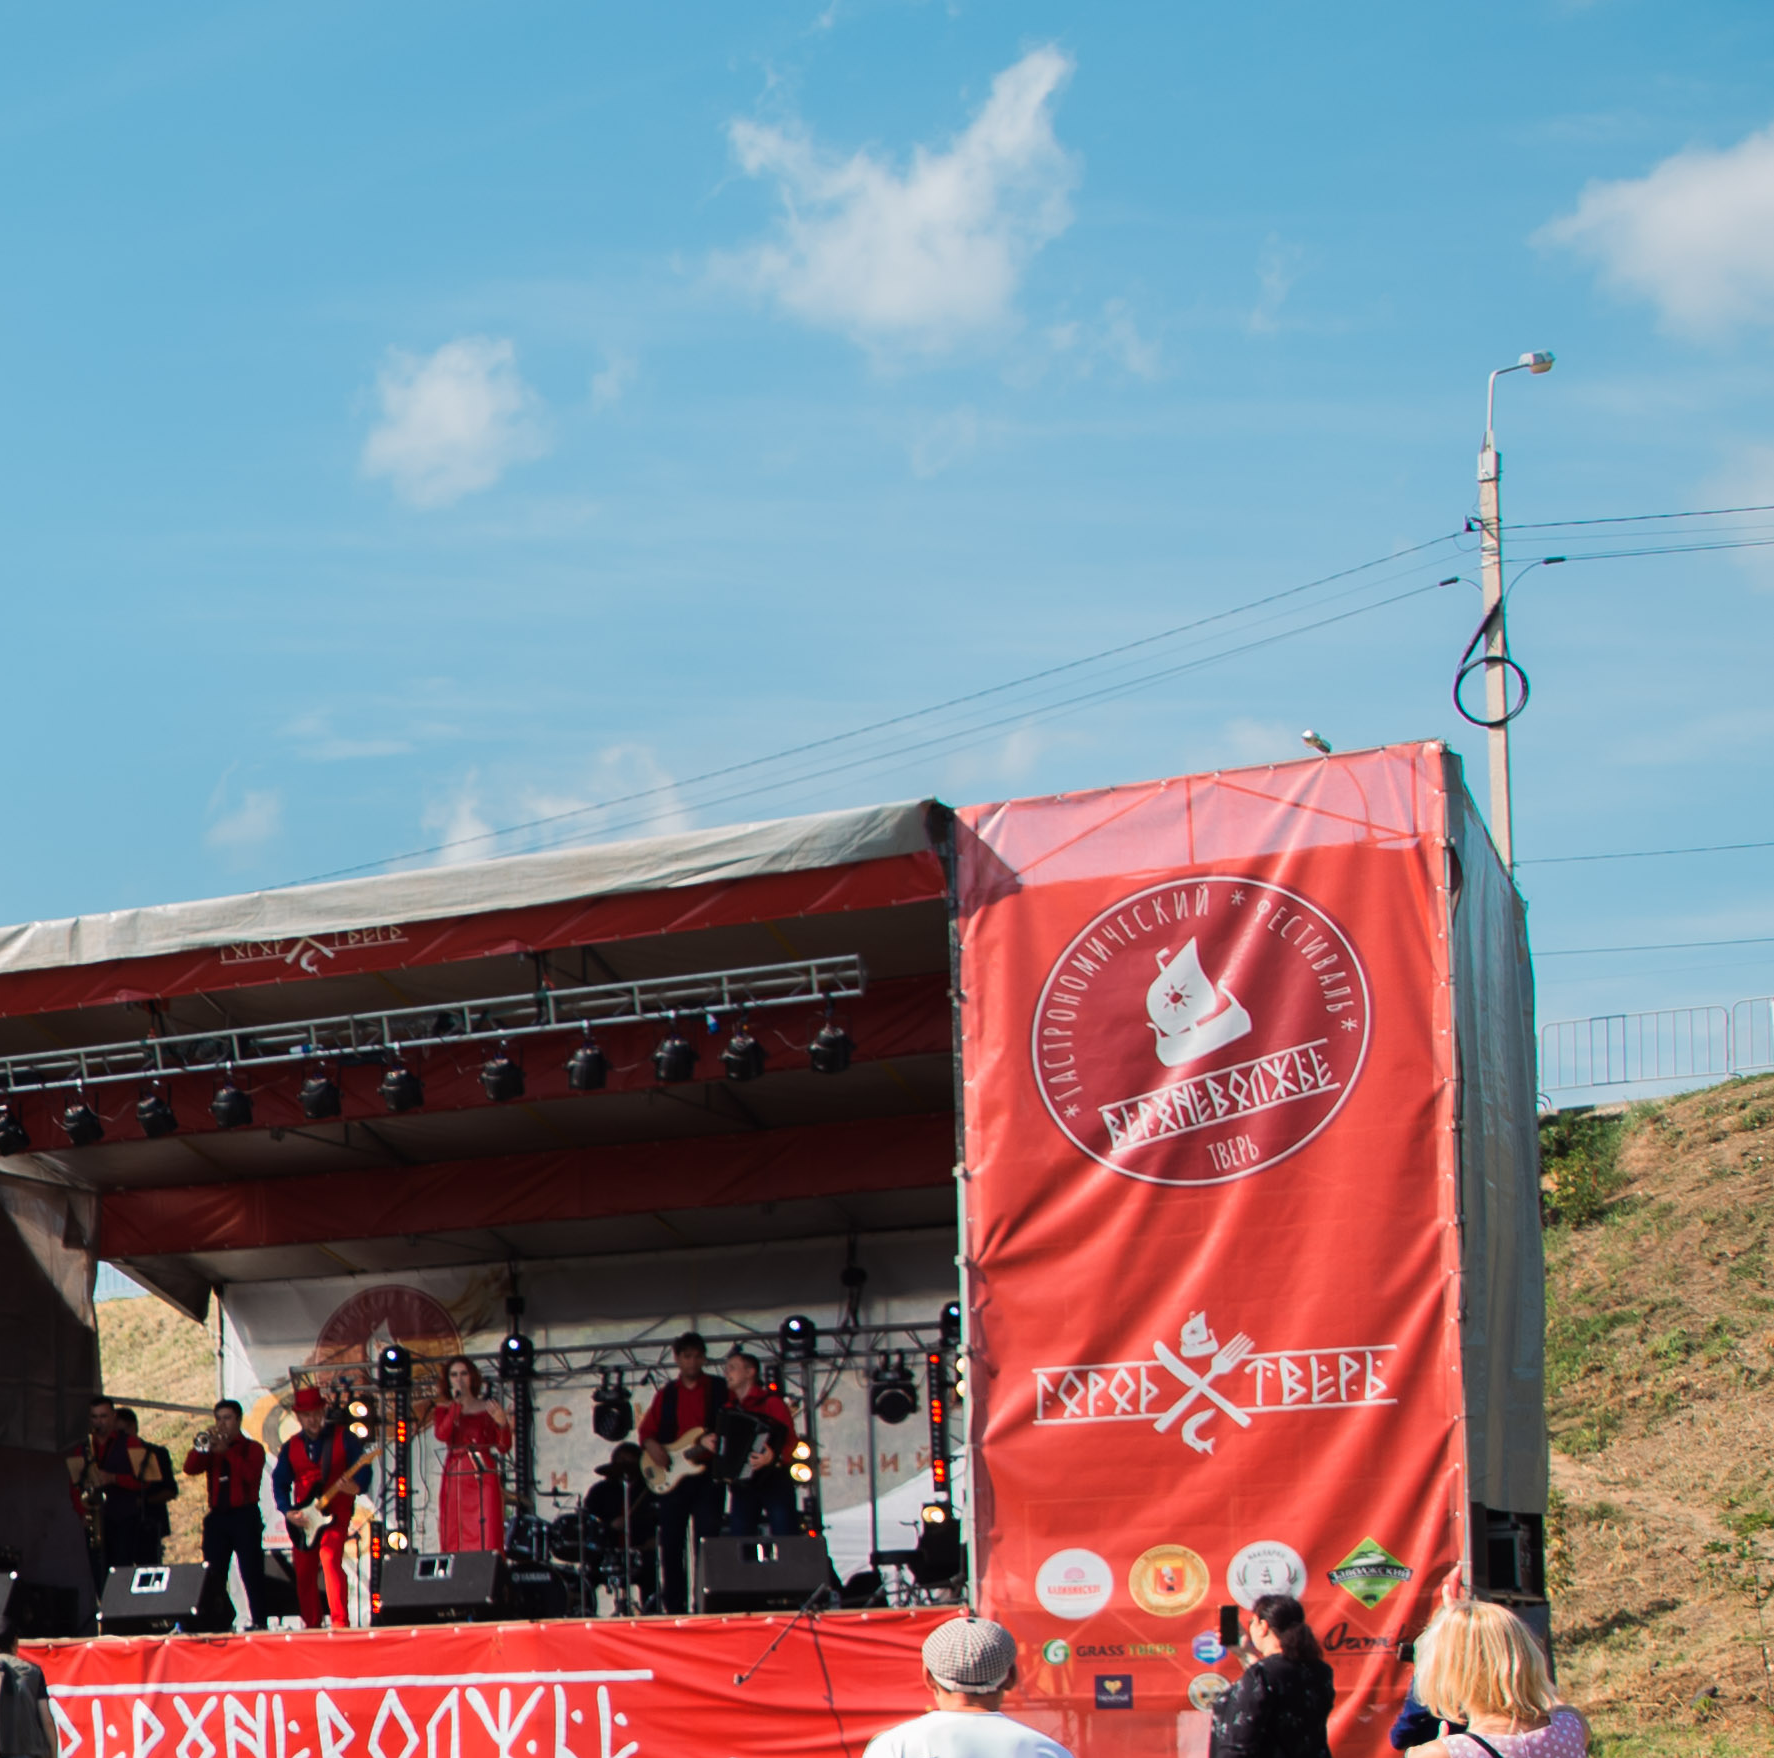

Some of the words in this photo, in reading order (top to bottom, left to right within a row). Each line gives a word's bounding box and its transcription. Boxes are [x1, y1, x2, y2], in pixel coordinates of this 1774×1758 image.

[1043, 884, 1211, 1104] ГАСТРОНОМИЧЕСКИЙ
[1257, 898, 1356, 1014] ФЕСТИВАЛЬ
[1207, 1134, 1260, 1173] ТВЕРЬ
[1244, 1351, 1387, 1407] ТВЕРЬ
[1077, 1645, 1124, 1656] GRASS
